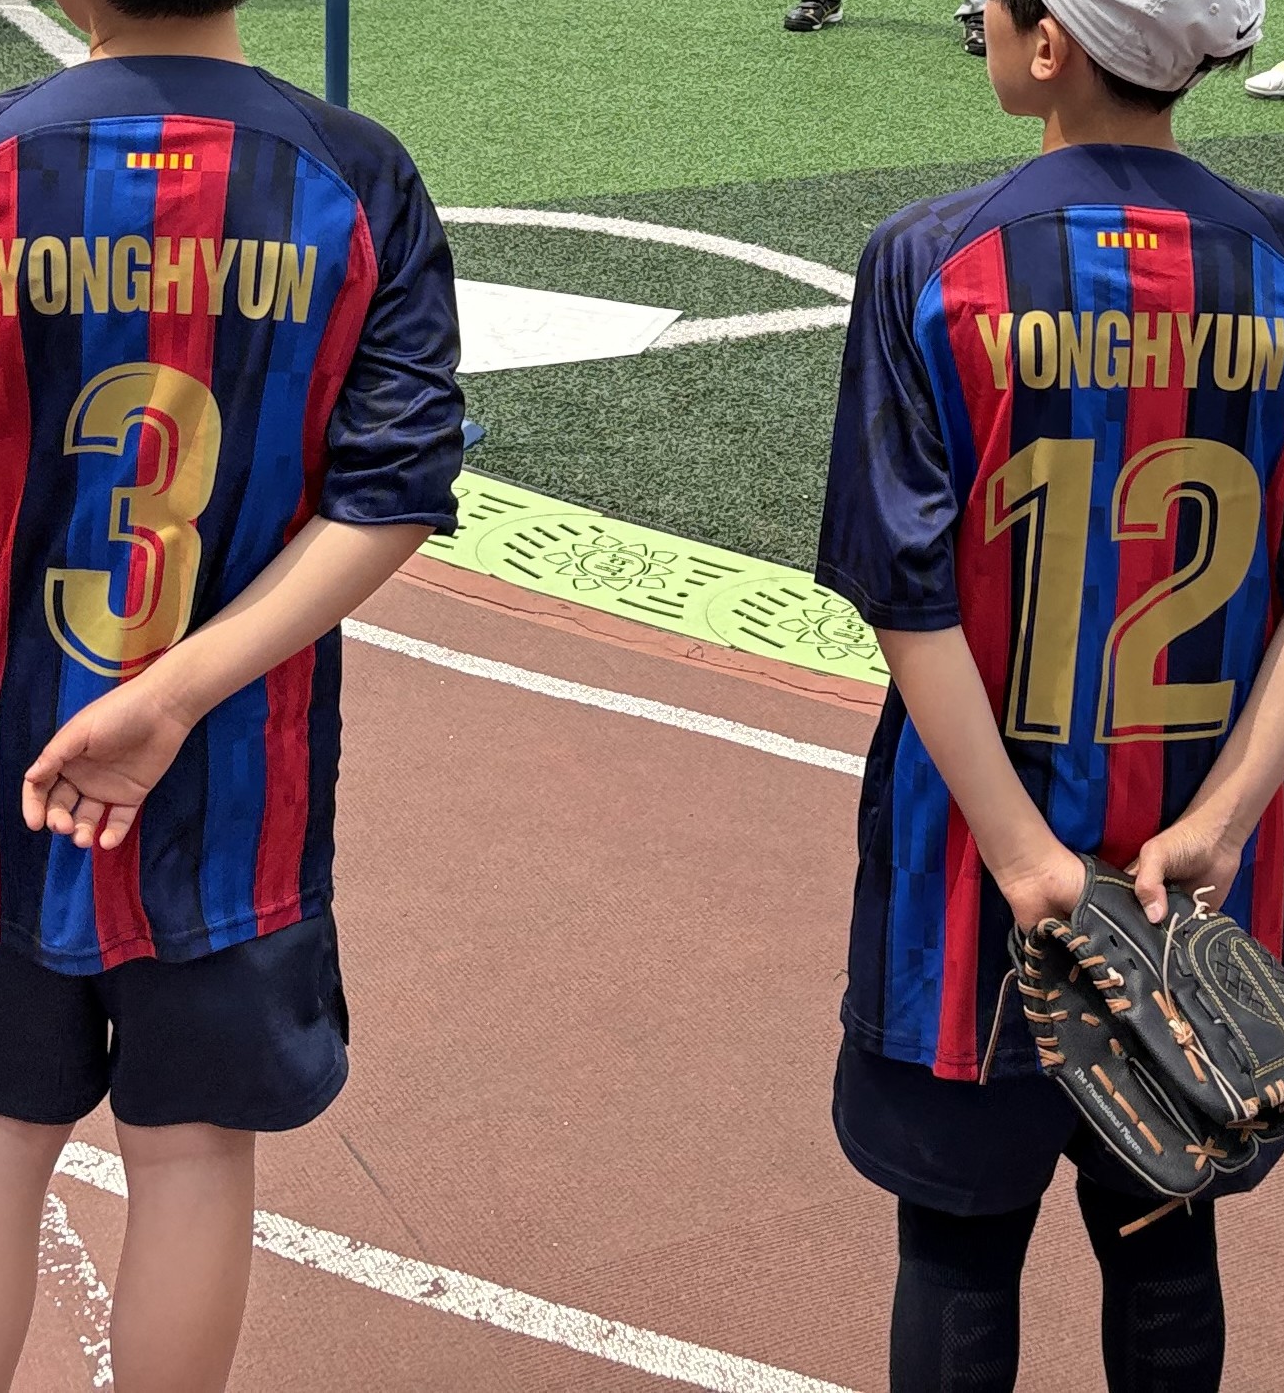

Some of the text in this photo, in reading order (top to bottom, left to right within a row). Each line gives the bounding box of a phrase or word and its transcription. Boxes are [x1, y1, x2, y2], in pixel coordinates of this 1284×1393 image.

[44, 360, 224, 678] 3
[984, 437, 1263, 745] 12
[1075, 1067, 1088, 1085] The
